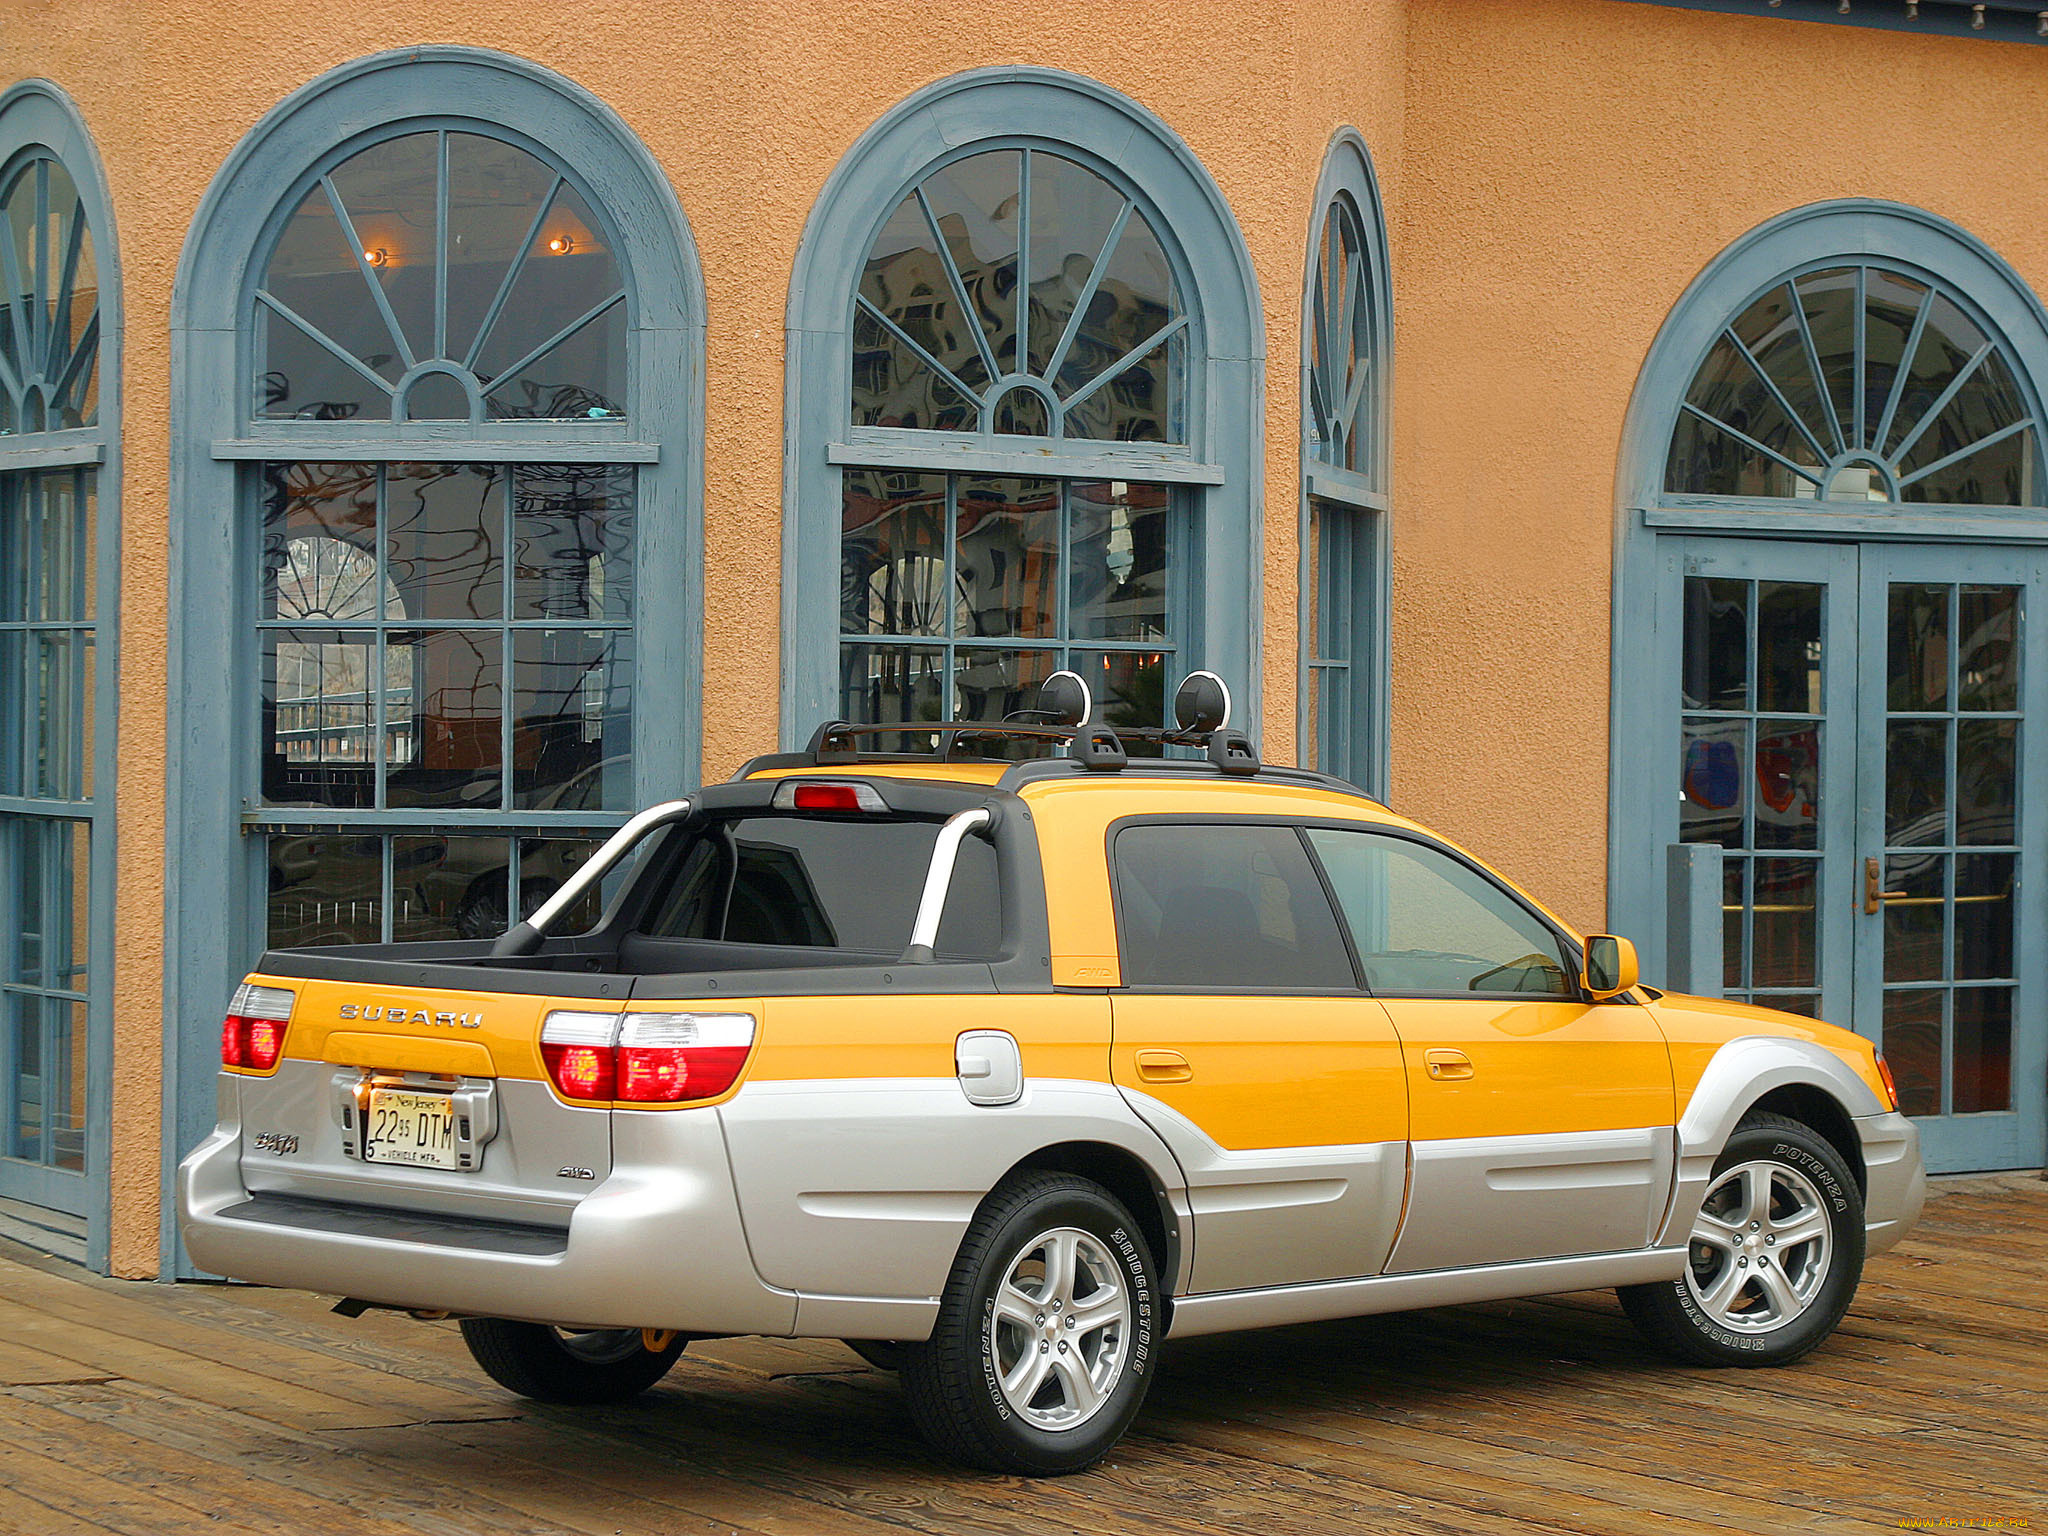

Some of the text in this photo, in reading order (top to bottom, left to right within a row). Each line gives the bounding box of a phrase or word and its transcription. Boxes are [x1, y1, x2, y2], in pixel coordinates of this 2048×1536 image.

[340, 1004, 483, 1028] SUBARU
[254, 1132, 299, 1156] BAJA
[417, 1113, 453, 1150] DTM
[1773, 1144, 1847, 1212] POTENZA
[1110, 1228, 1150, 1376] BRIDGESTONE
[1674, 1278, 1765, 1351] BRIDGESTON
[981, 1297, 1010, 1420] POTENZA
